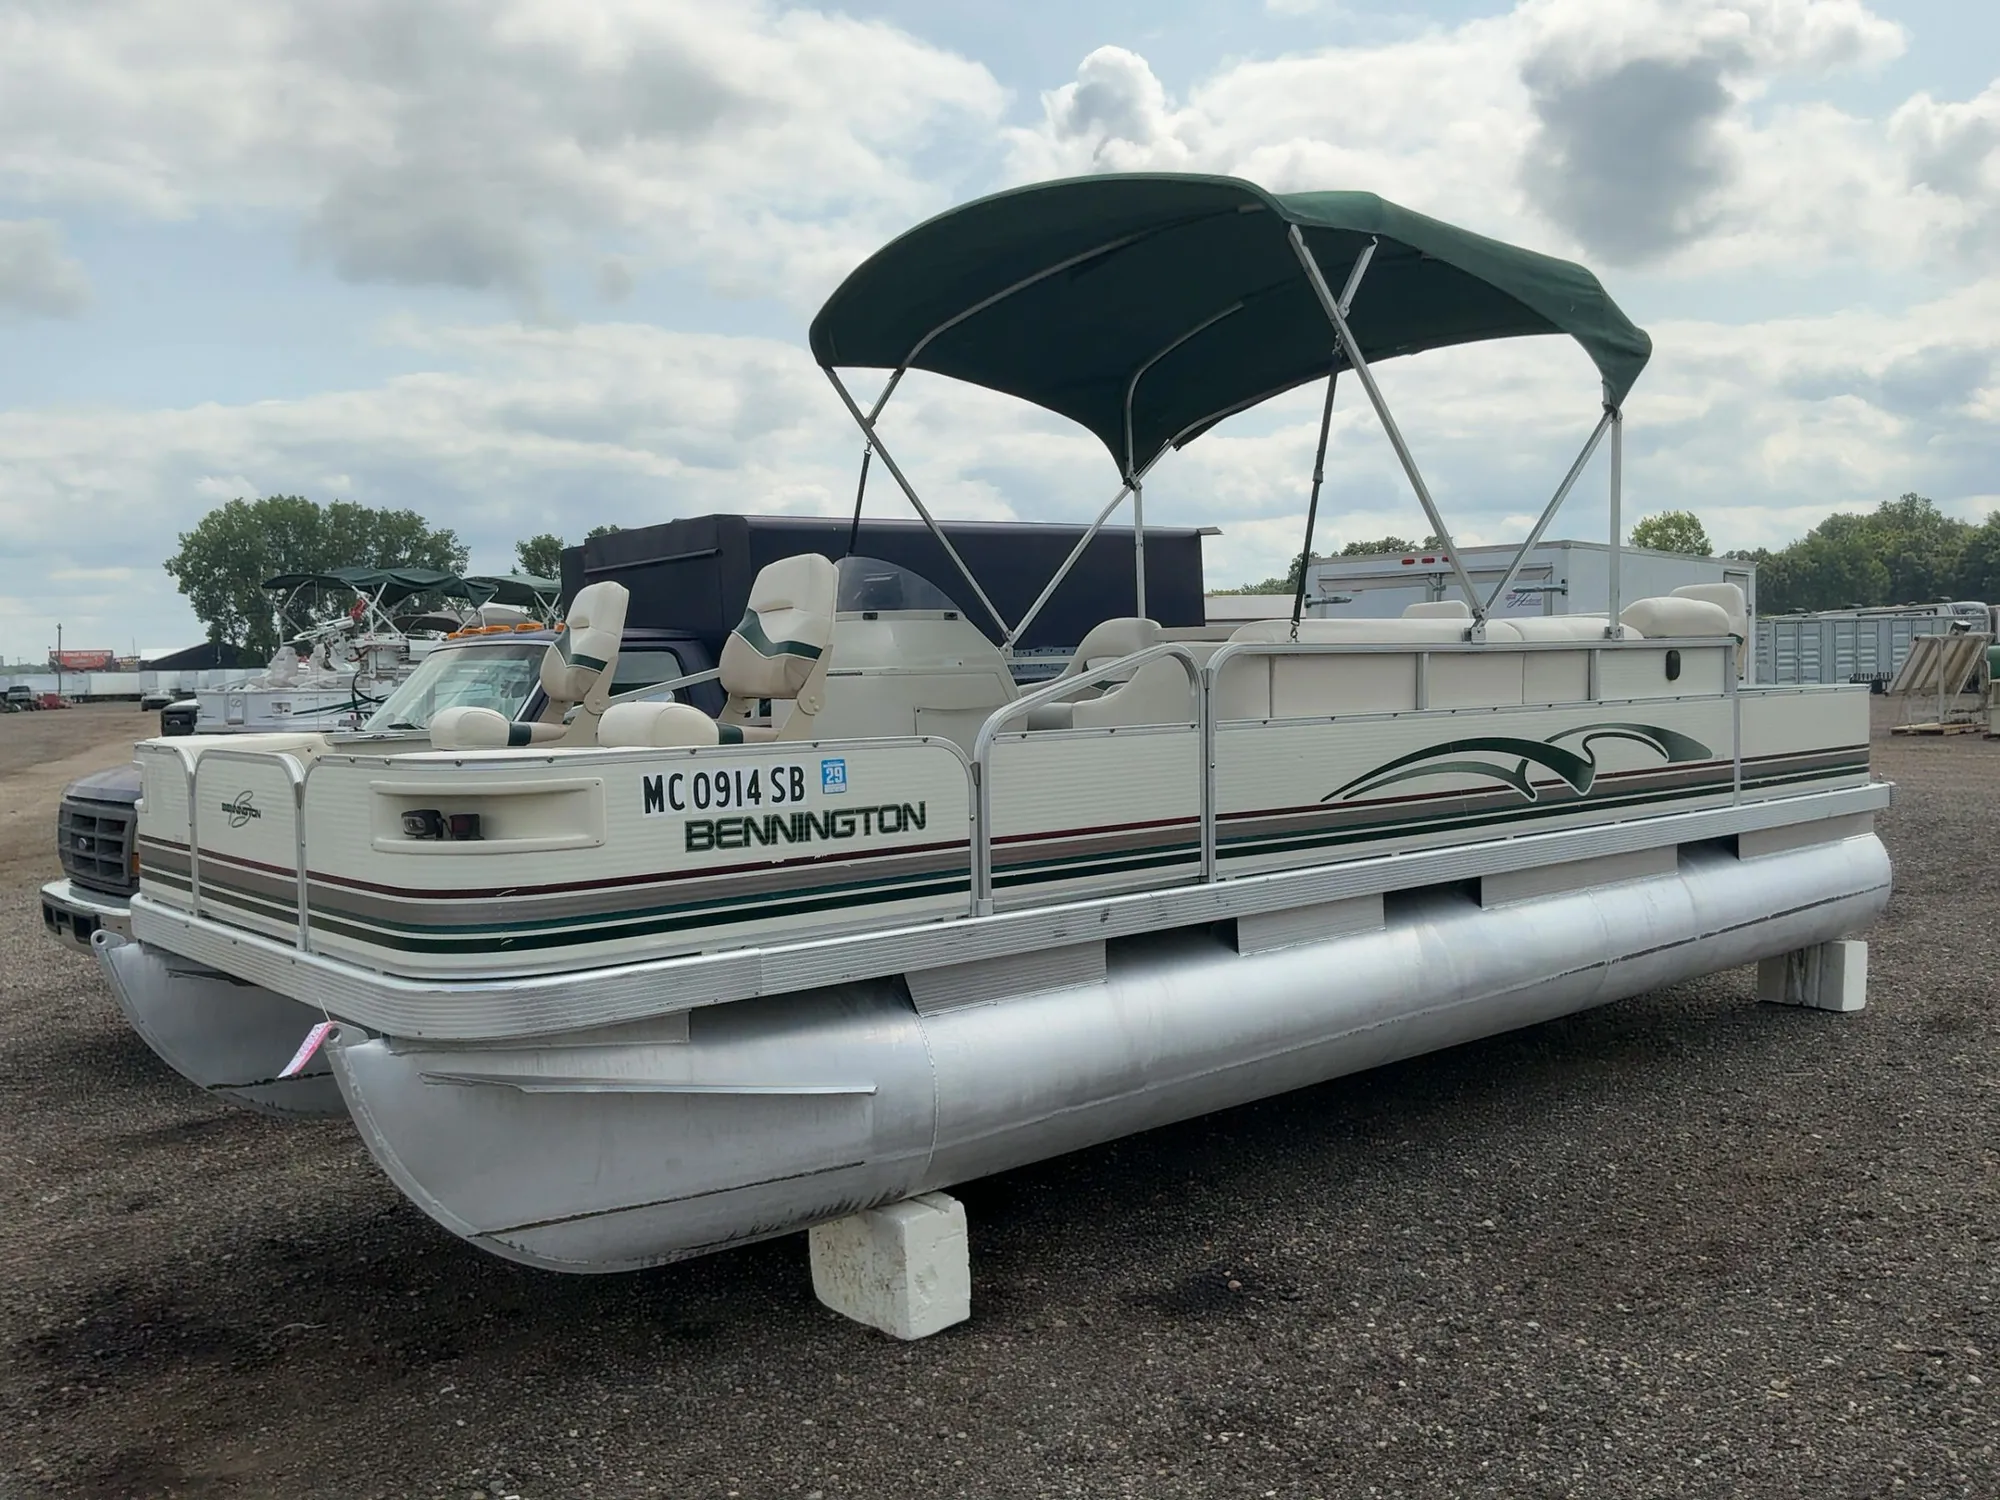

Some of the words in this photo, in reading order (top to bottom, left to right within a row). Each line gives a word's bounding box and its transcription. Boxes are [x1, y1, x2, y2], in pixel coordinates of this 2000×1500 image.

[771, 766, 805, 803] SB
[826, 766, 843, 784] 29
[685, 801, 926, 853] BENNINGTON
